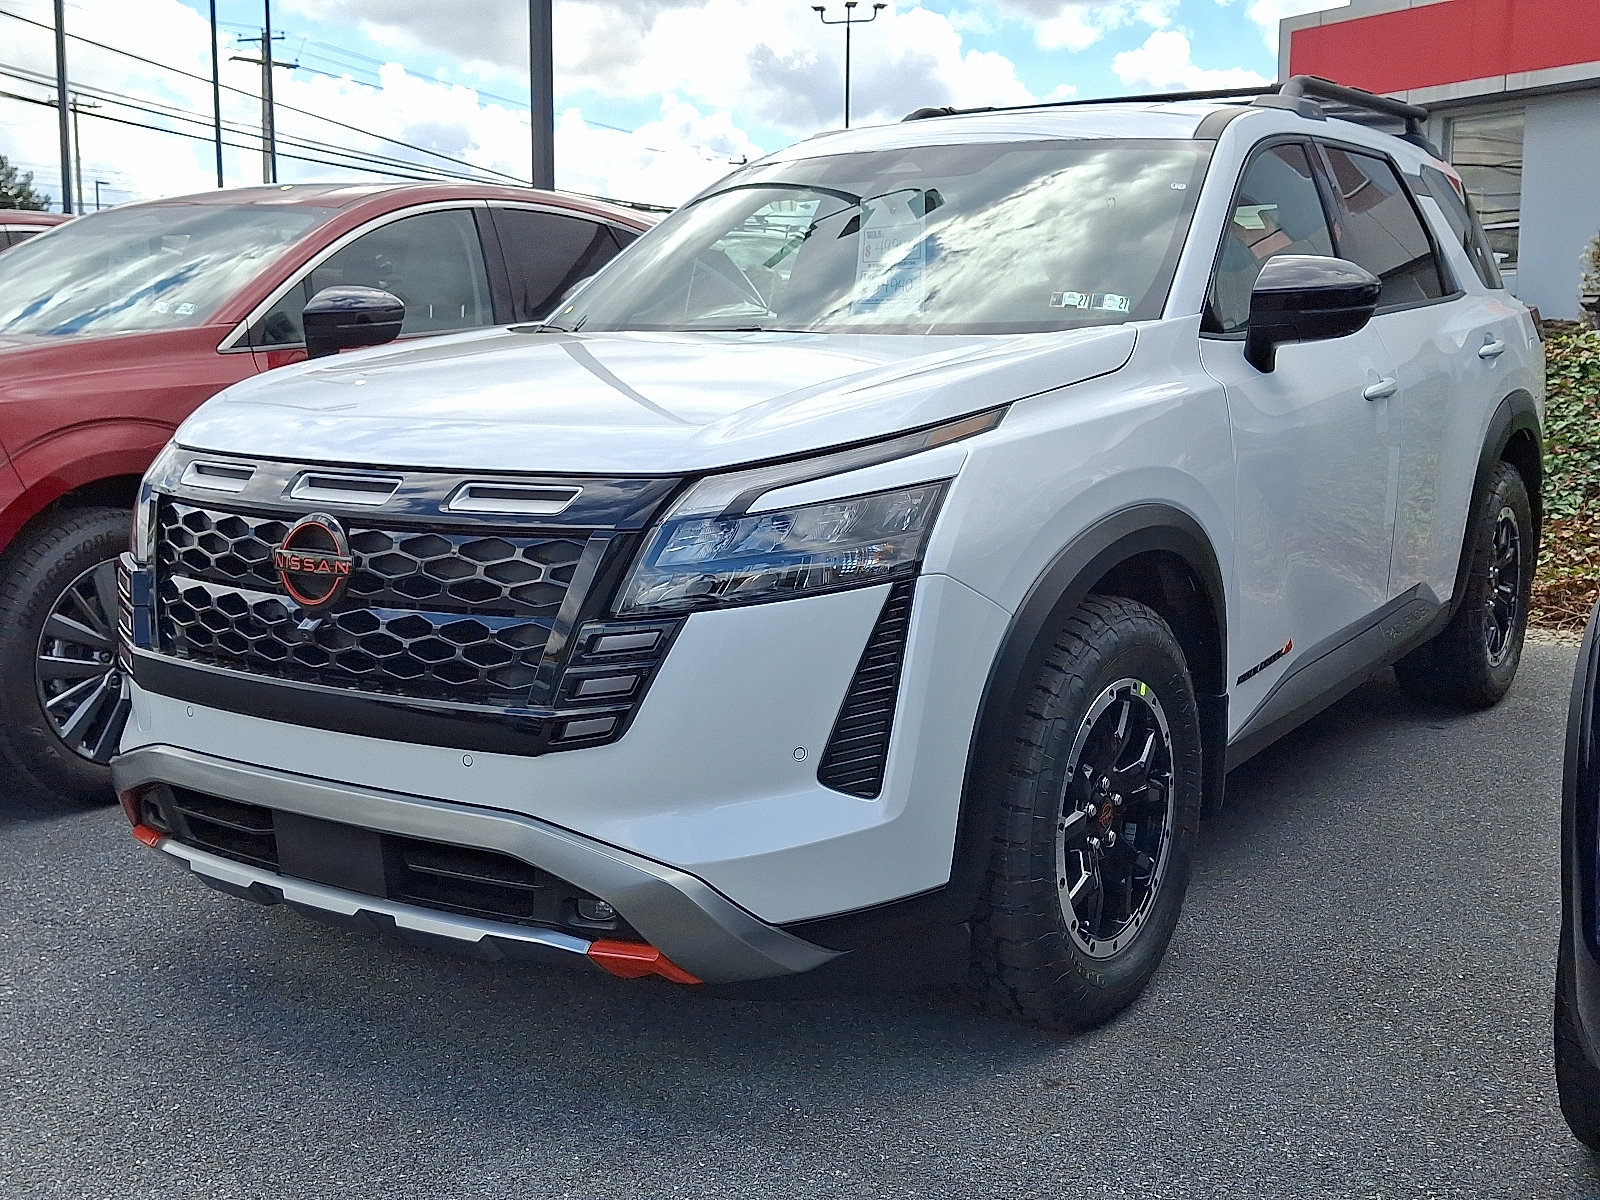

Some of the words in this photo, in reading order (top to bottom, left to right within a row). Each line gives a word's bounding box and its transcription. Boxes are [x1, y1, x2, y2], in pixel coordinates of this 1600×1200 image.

[1078, 294, 1088, 307] 27
[1118, 297, 1129, 310] 27
[275, 553, 350, 574] NISSAN
